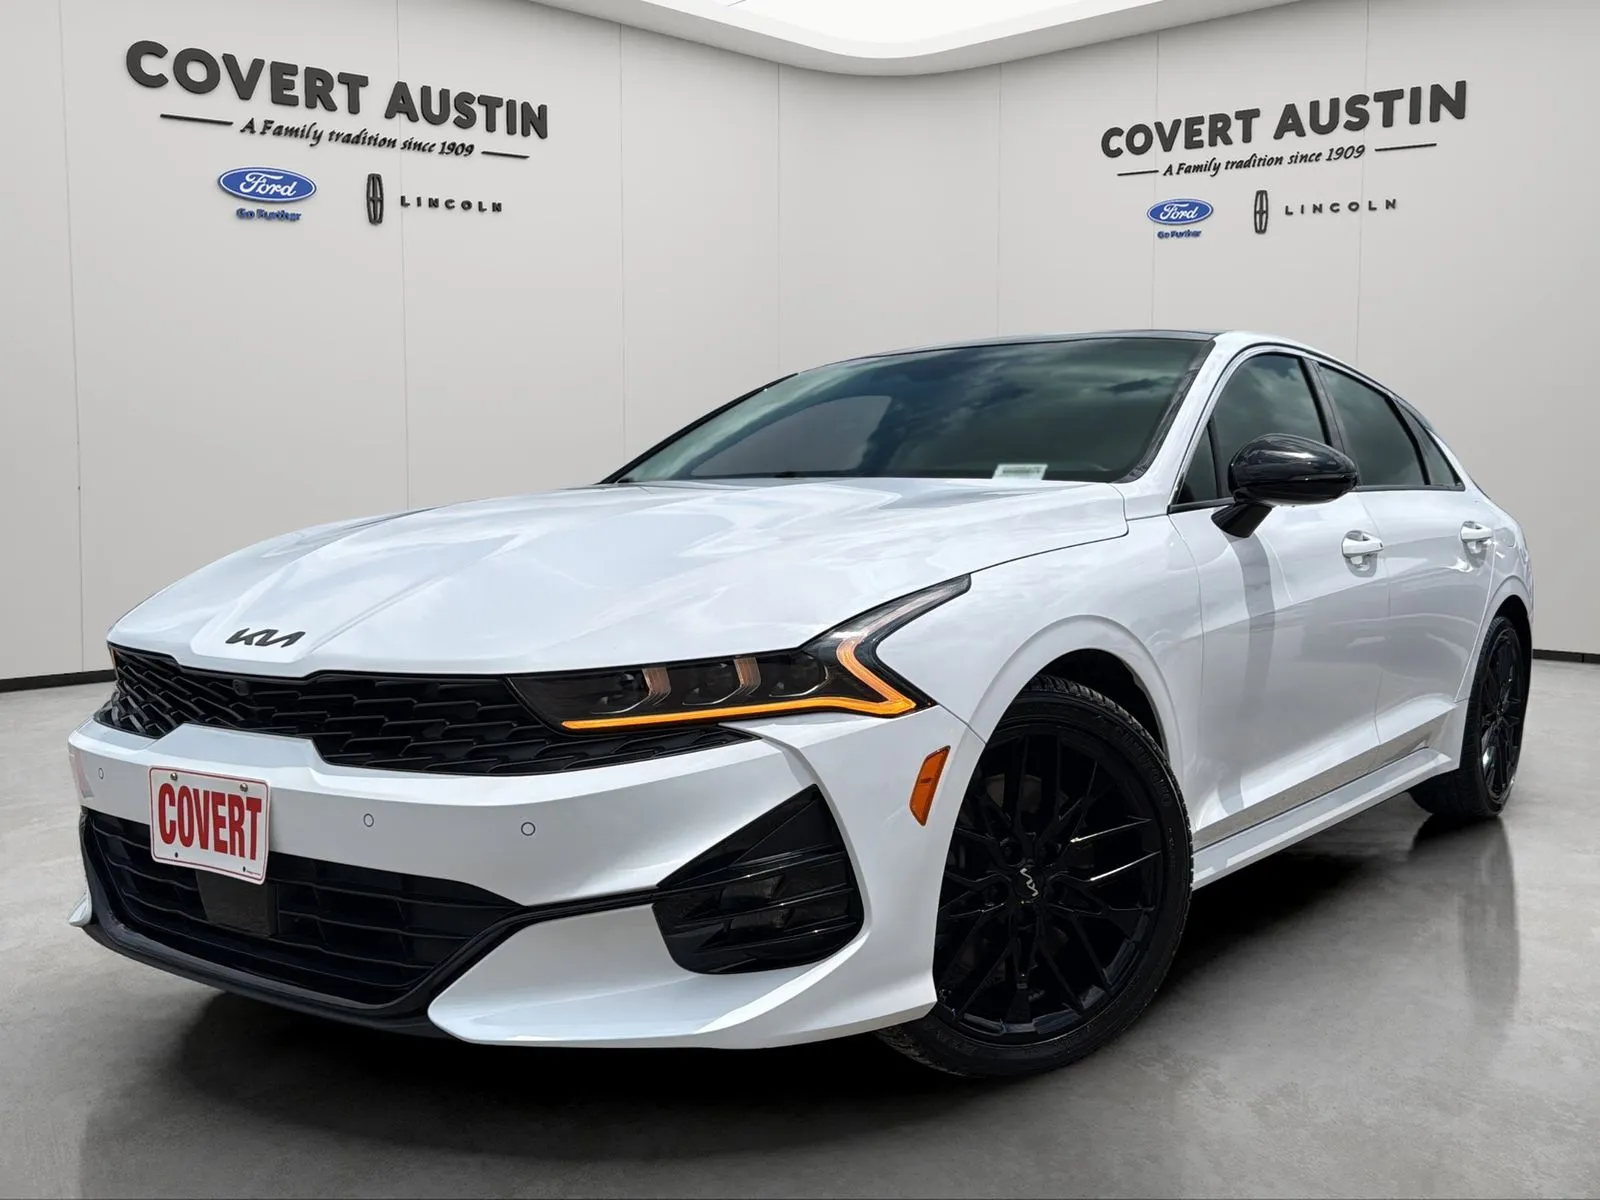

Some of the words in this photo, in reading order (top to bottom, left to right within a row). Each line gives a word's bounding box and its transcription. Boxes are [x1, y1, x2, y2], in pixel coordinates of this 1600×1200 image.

[126, 40, 368, 114] COVERT
[384, 81, 548, 139] AUSTIN
[1101, 108, 1260, 158] COVERT
[1273, 80, 1466, 139] AUSTIN
[240, 118, 256, 134] A
[259, 119, 324, 147] Family
[328, 128, 397, 149] tradition
[400, 136, 436, 155] since
[438, 140, 475, 157] 1909
[1163, 164, 1174, 177] A
[1175, 158, 1221, 177] Family
[1224, 154, 1283, 171] tradition
[1287, 150, 1322, 165] since
[1325, 144, 1366, 161] 1909
[239, 173, 298, 198] Ford
[400, 195, 502, 213] LINCOLN
[1159, 203, 1199, 220] Ford
[1285, 199, 1397, 216] LINCOLN
[158, 782, 262, 861] COVERT
